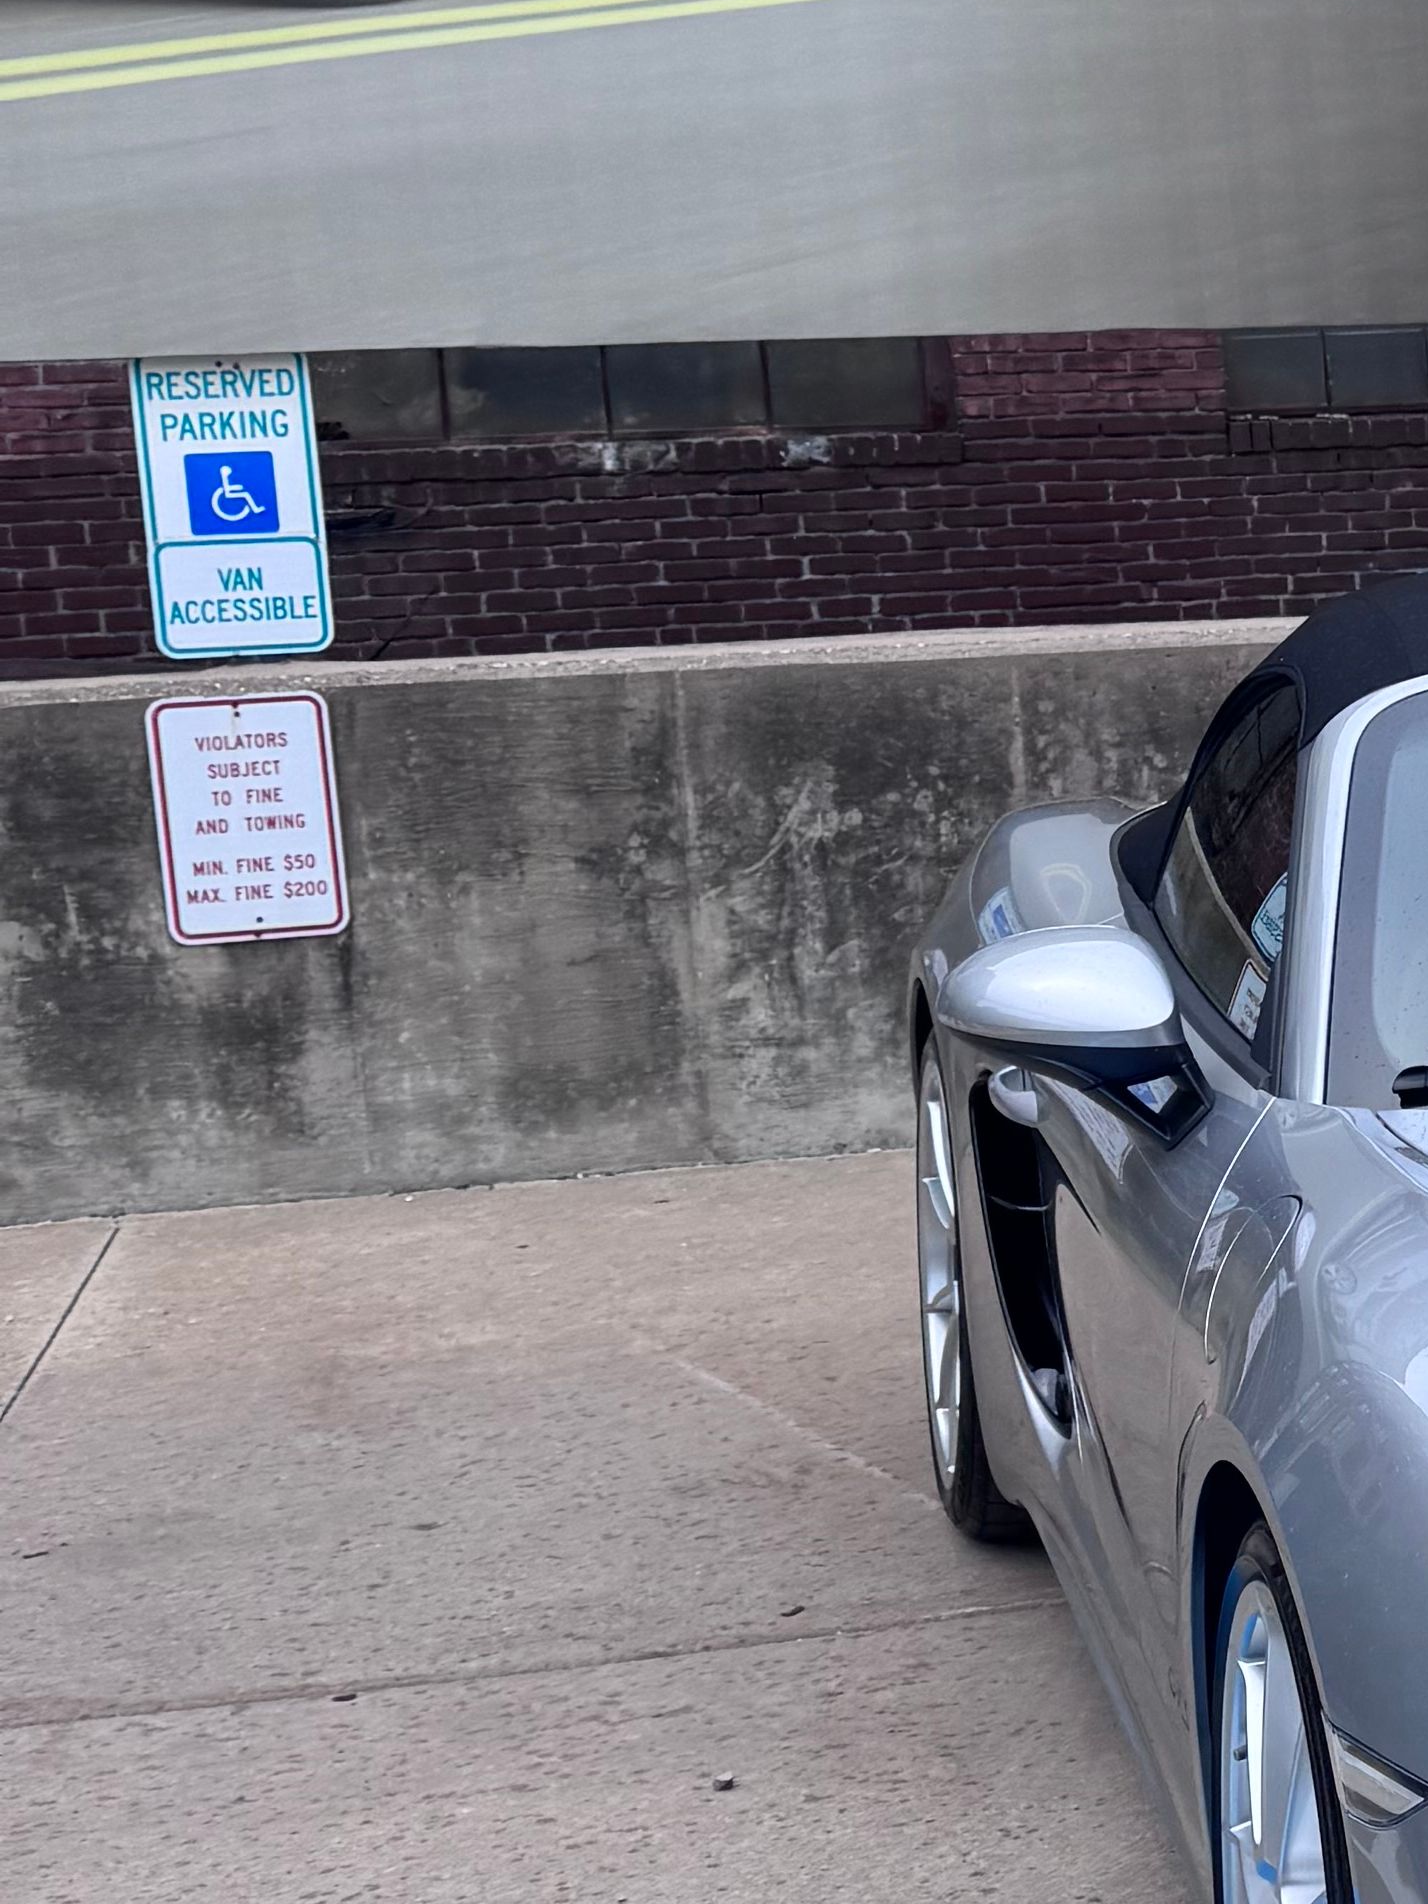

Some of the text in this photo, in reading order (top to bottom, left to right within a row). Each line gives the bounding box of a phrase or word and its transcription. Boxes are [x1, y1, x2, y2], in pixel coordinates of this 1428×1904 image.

[145, 368, 295, 400] RESERVED
[160, 409, 289, 441] PARKING
[217, 567, 263, 592] VAN
[169, 595, 318, 625] ACCESSIBLE
[194, 732, 288, 752] VIOLATORS
[207, 760, 281, 779] SUBJECT
[211, 788, 284, 807] TO FINE
[195, 813, 306, 835] AND TOWING
[192, 854, 316, 876] MIN. FINE $50
[186, 880, 328, 904] MAX. FINE $200
